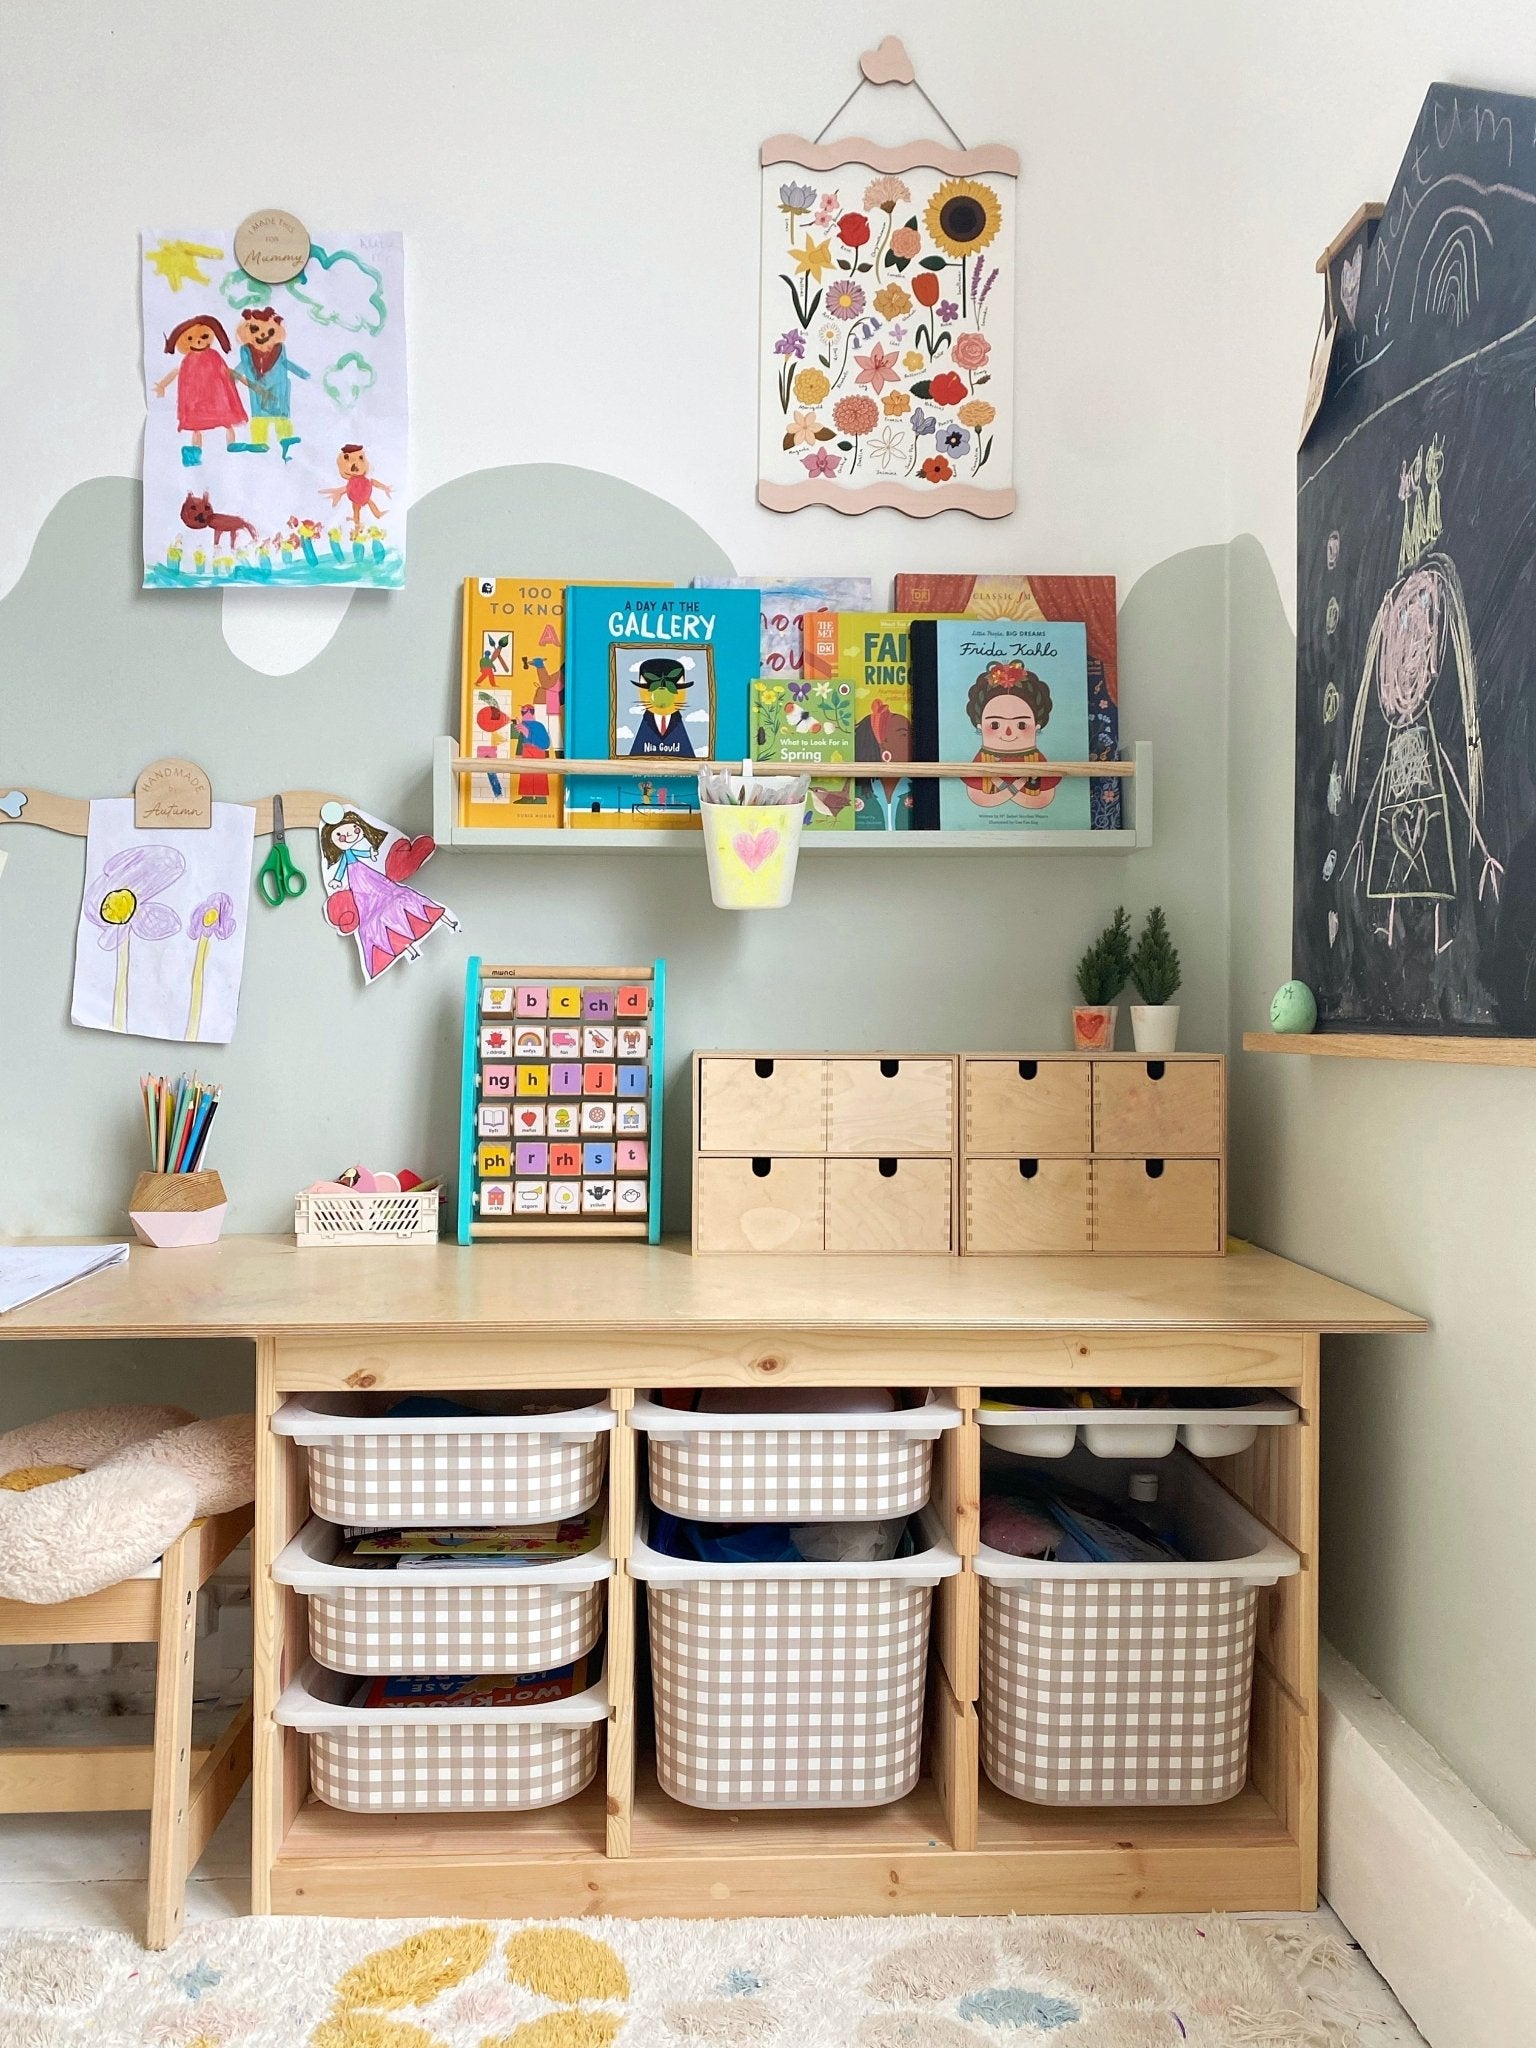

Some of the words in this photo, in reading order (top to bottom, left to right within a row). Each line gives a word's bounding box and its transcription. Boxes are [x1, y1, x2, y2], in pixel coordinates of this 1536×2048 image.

[244, 250, 304, 267] Mummy
[519, 587, 552, 599] 100
[914, 591, 928, 600] DK
[973, 592, 1013, 600] CLASSIC
[490, 603, 514, 615] TO
[524, 604, 564, 616] KNO
[625, 601, 631, 611] A
[636, 601, 657, 611] DAY
[661, 602, 674, 612] AT
[679, 602, 700, 612] THE
[608, 611, 716, 641] GALLERY
[538, 624, 562, 648] A
[819, 644, 832, 652] DK
[960, 642, 1007, 656] Frida
[1009, 642, 1058, 657] Kahlo
[644, 742, 657, 753] Nia
[659, 742, 680, 752] Gould
[781, 748, 822, 763] Spring
[142, 767, 205, 793] HANDMADE
[143, 802, 203, 818] Autumn
[526, 994, 537, 1007] b
[561, 998, 569, 1007] c
[589, 1000, 608, 1011] ch
[627, 994, 637, 1006] d
[489, 1074, 509, 1089] ng
[528, 1073, 537, 1086] h
[564, 1072, 568, 1084] i
[595, 1072, 603, 1088] j
[630, 1074, 634, 1087] l
[528, 1153, 535, 1164] r
[557, 1153, 573, 1166] rh
[594, 1154, 603, 1164] s
[628, 1149, 636, 1160] t
[484, 1155, 505, 1170] ph
